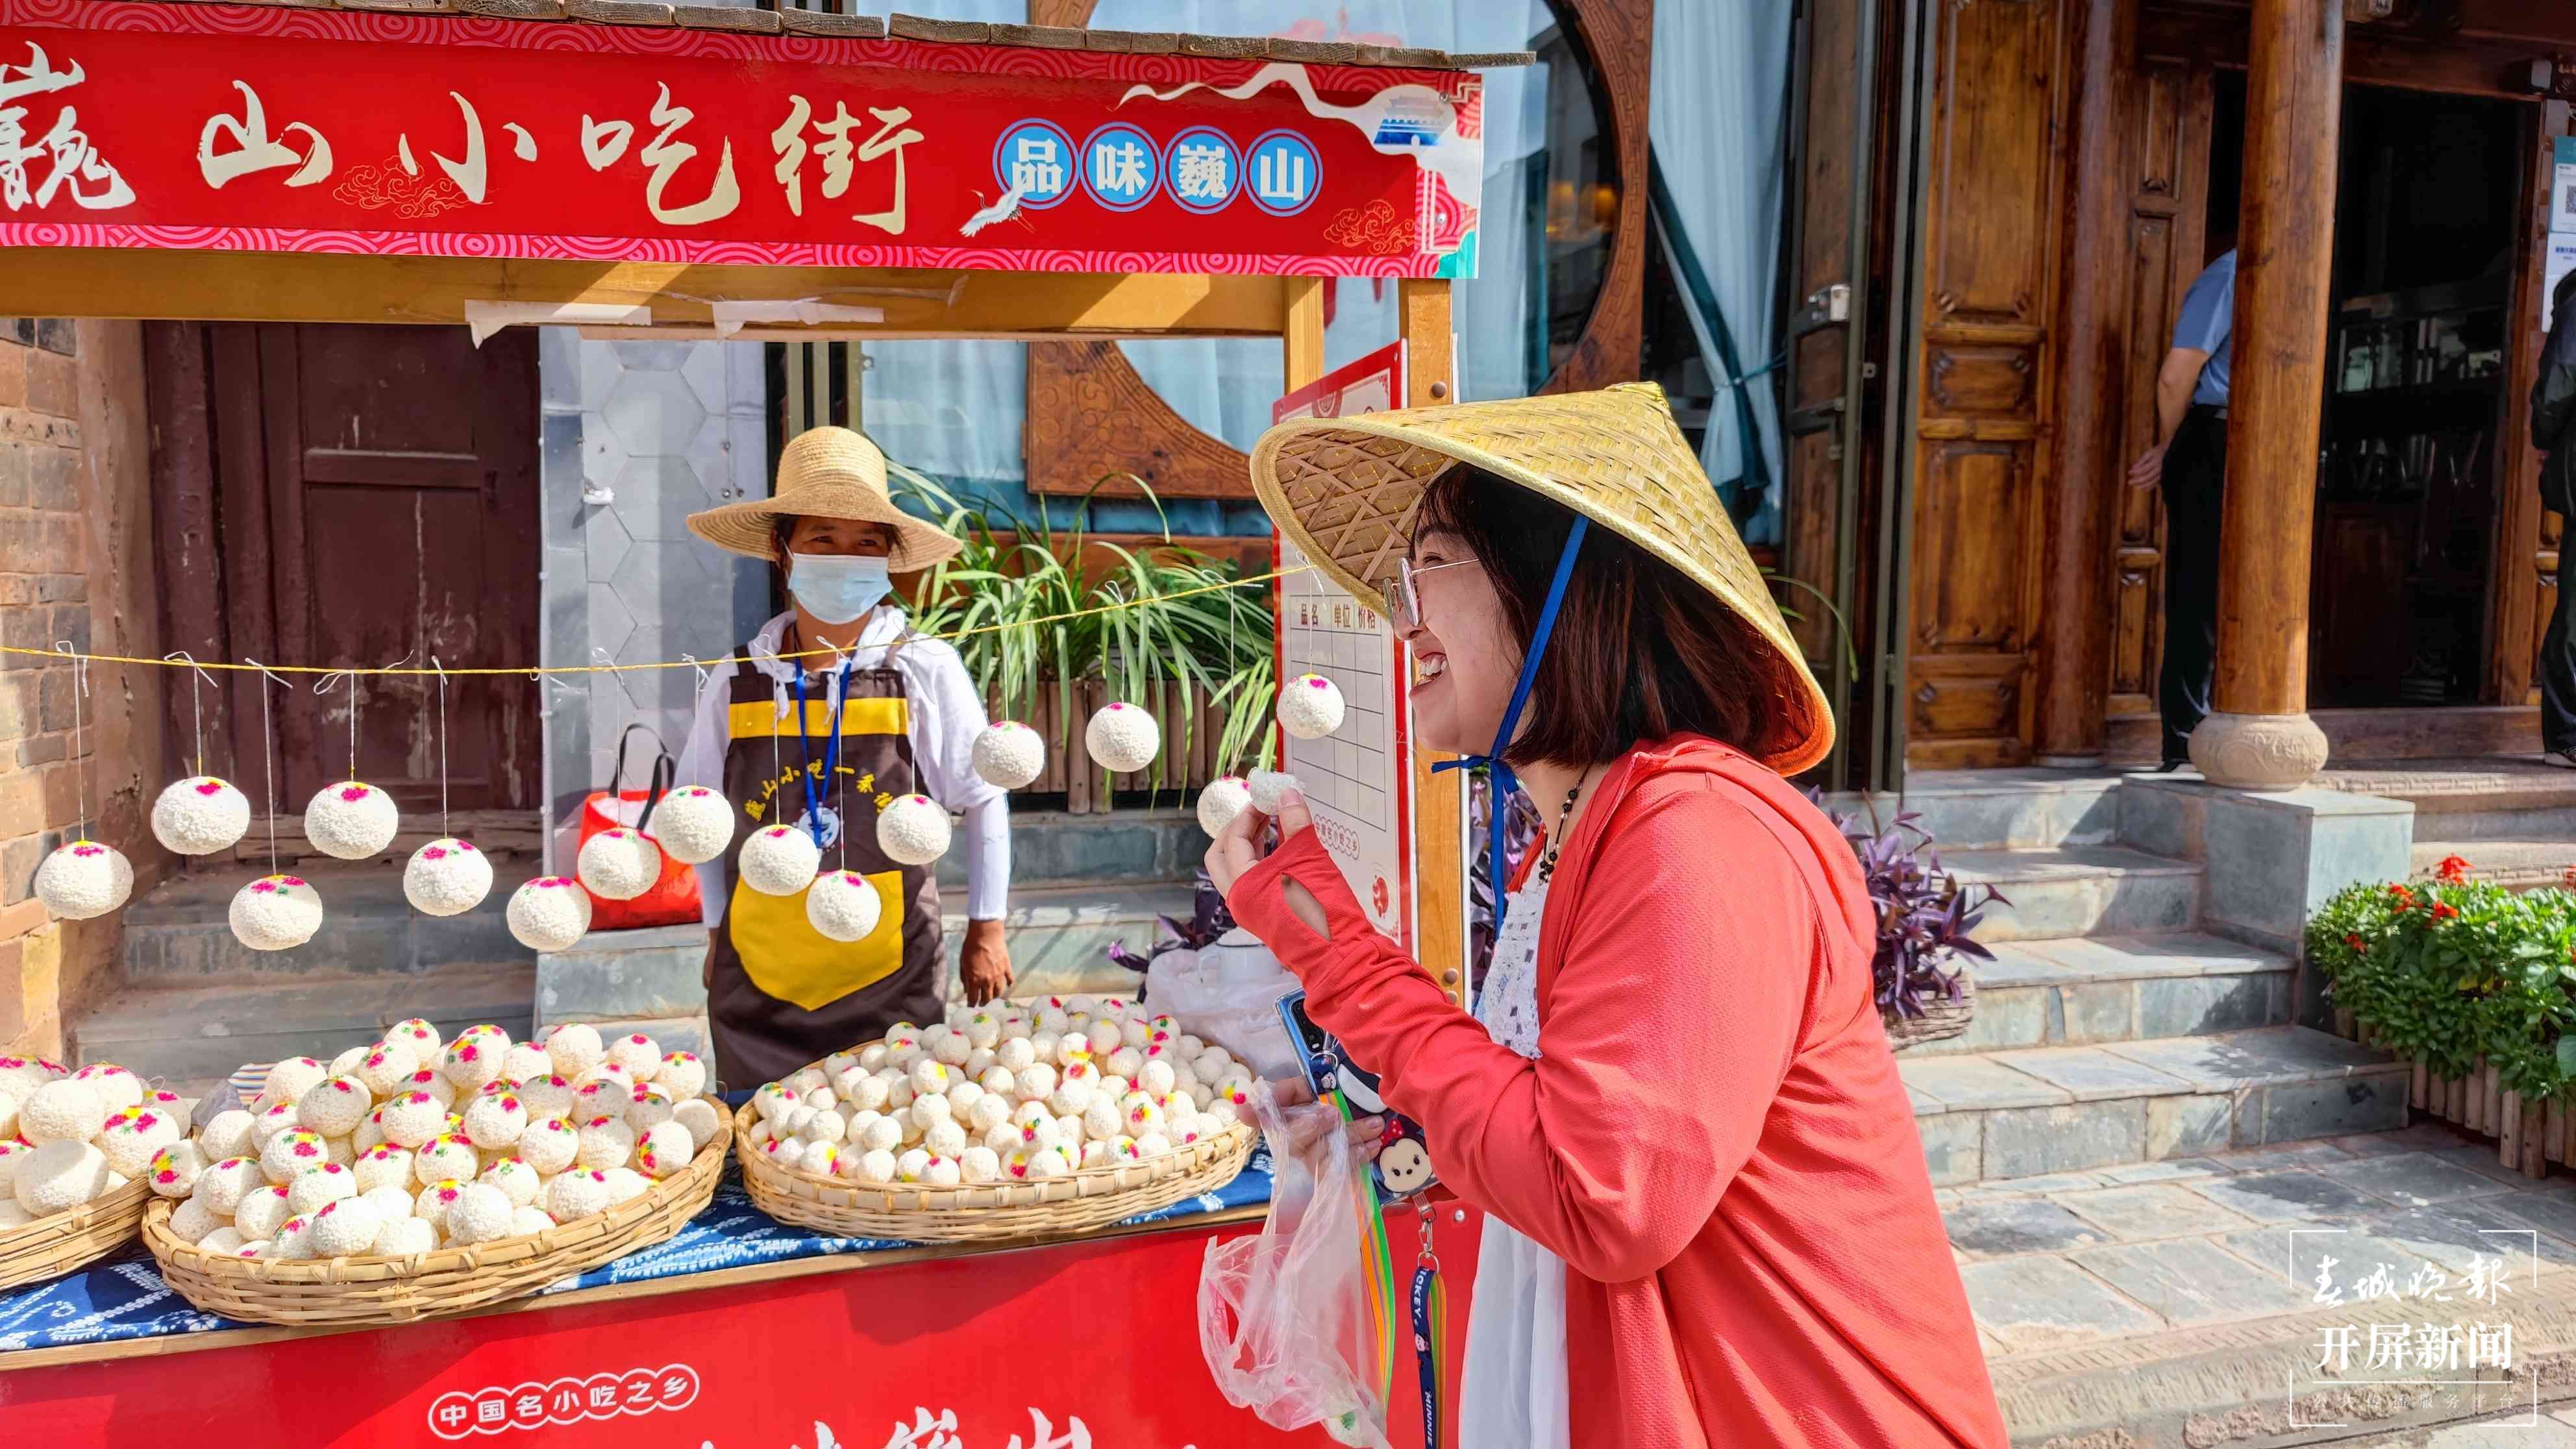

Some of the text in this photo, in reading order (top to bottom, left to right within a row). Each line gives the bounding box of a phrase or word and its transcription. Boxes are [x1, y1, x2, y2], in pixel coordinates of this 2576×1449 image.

[1011, 138, 1304, 201] 品味巍山
[1301, 602, 1376, 629] 品名 单位 价格
[440, 1375, 689, 1427] 中国名小吃之乡
